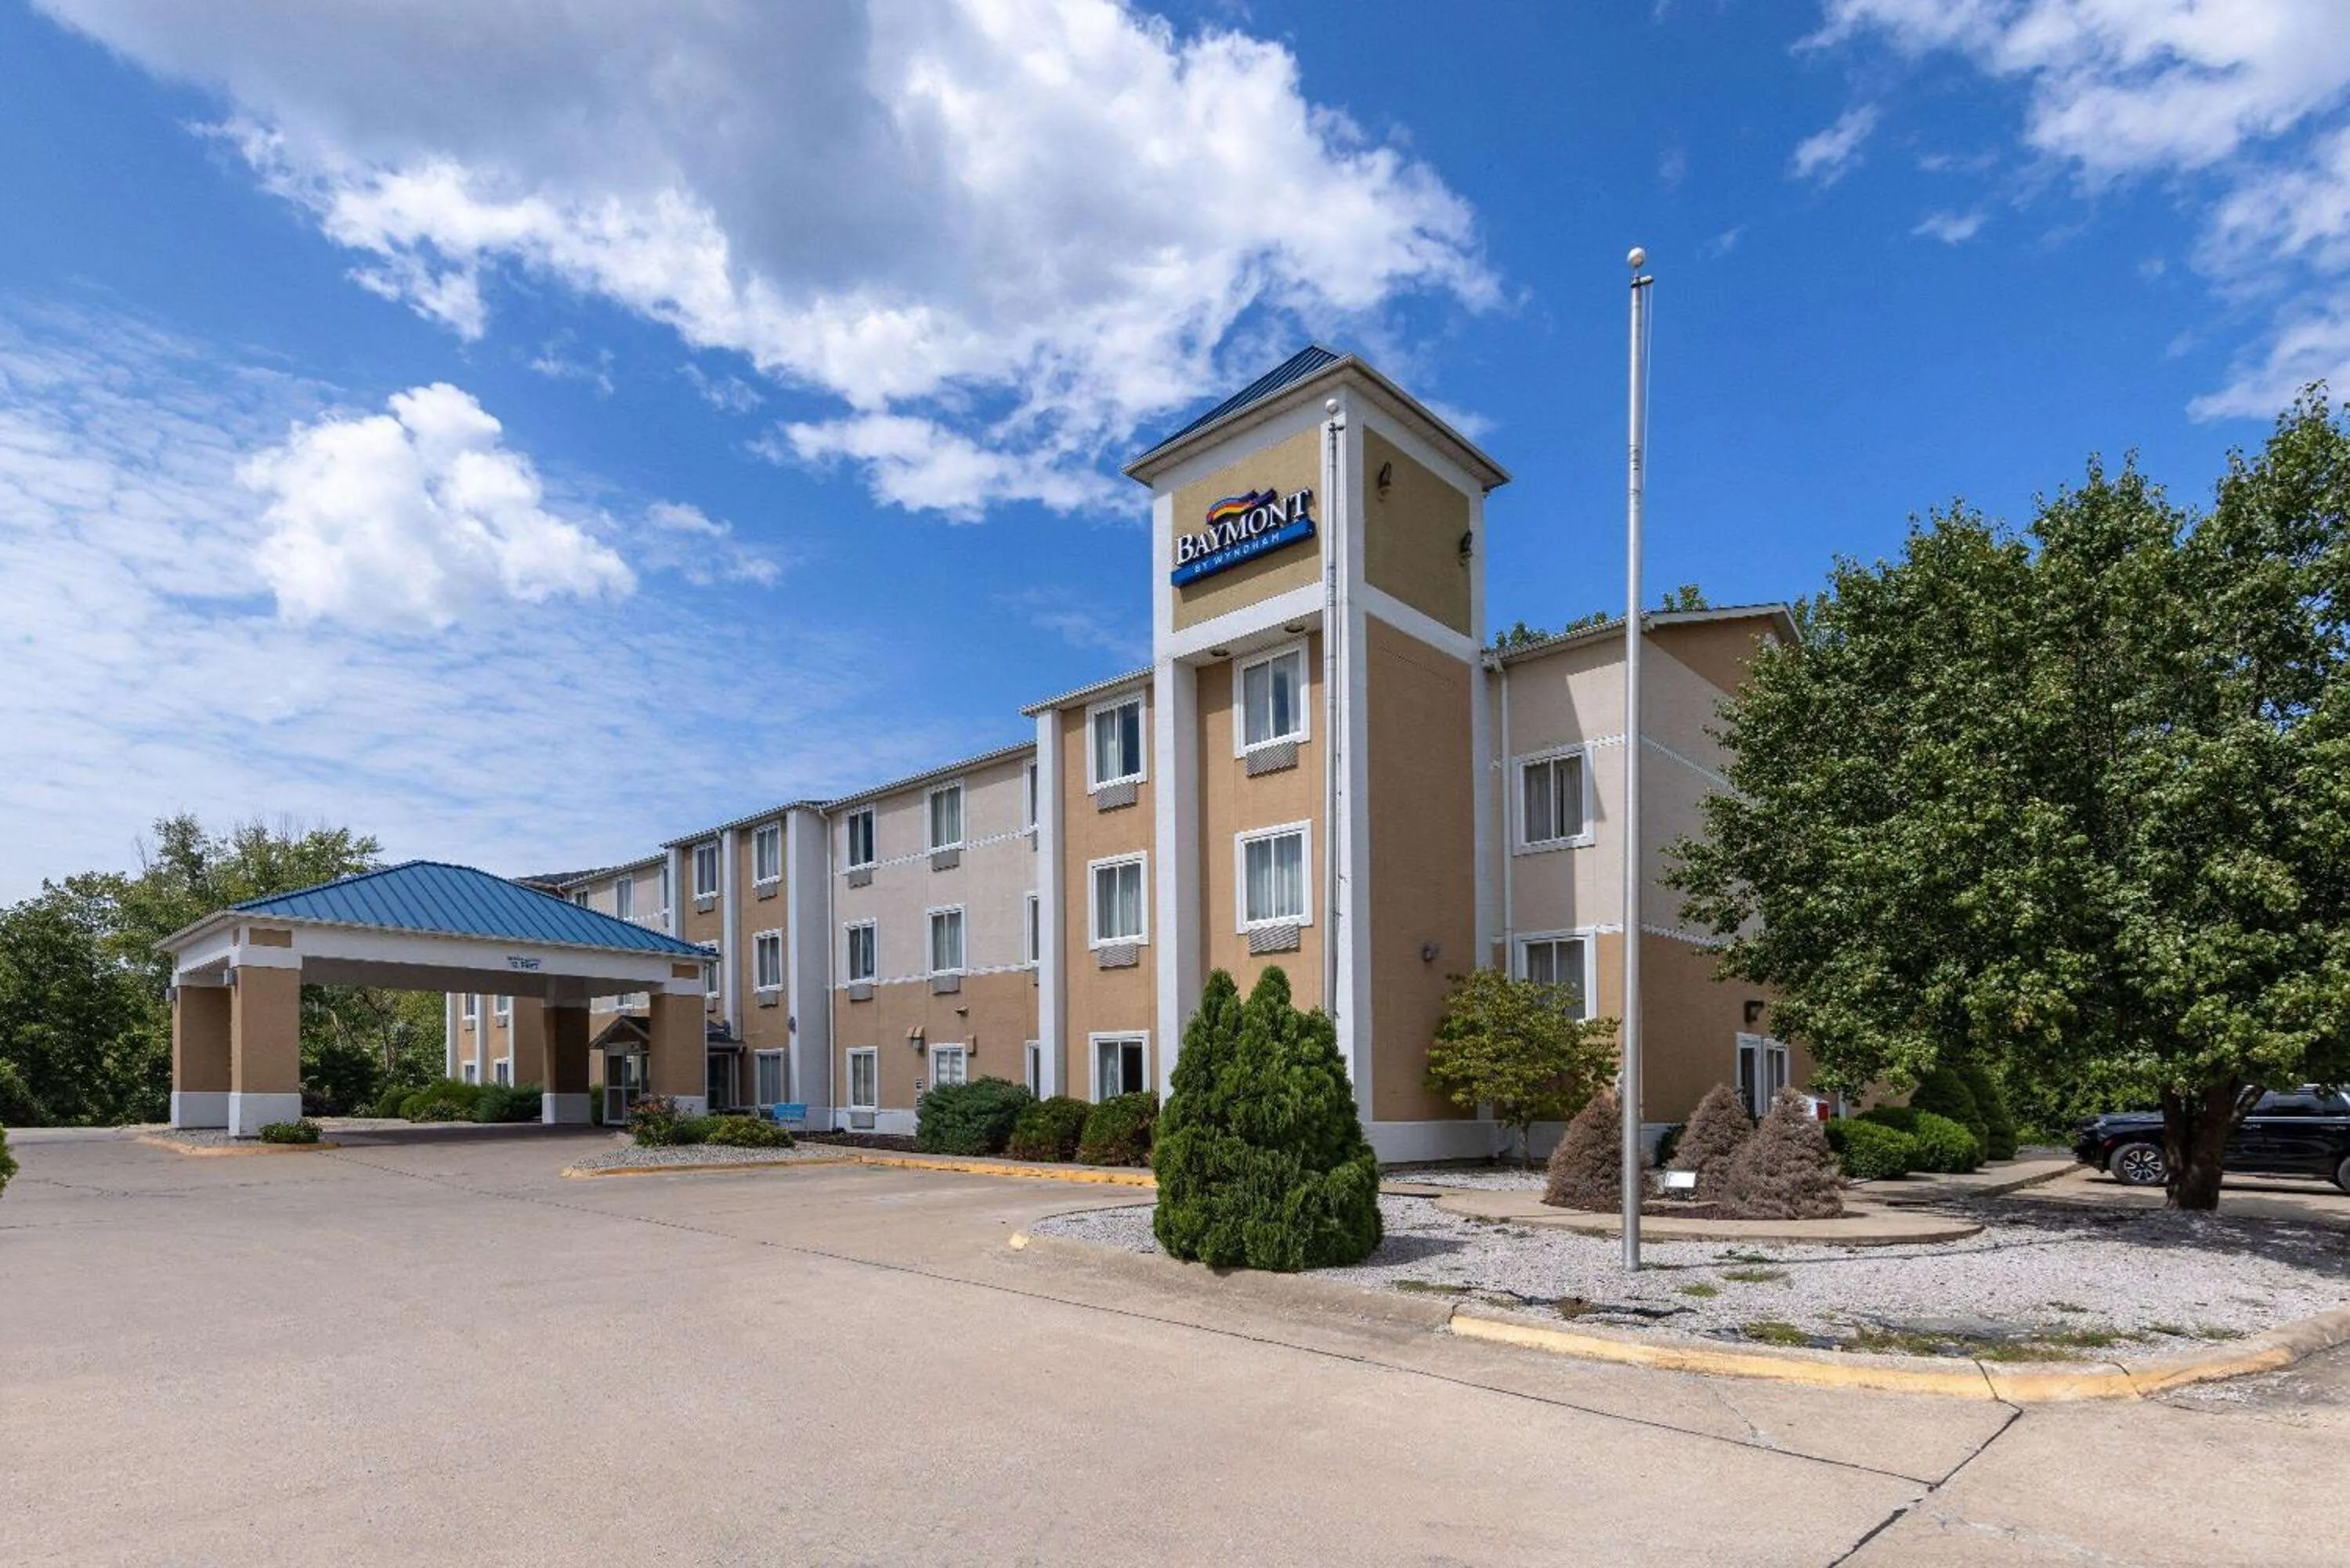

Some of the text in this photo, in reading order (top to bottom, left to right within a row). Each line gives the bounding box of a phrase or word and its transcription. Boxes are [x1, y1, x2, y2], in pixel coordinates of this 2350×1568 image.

[1175, 488, 1311, 565] BAYMONT
[1194, 532, 1280, 573] BY WYNDHAM
